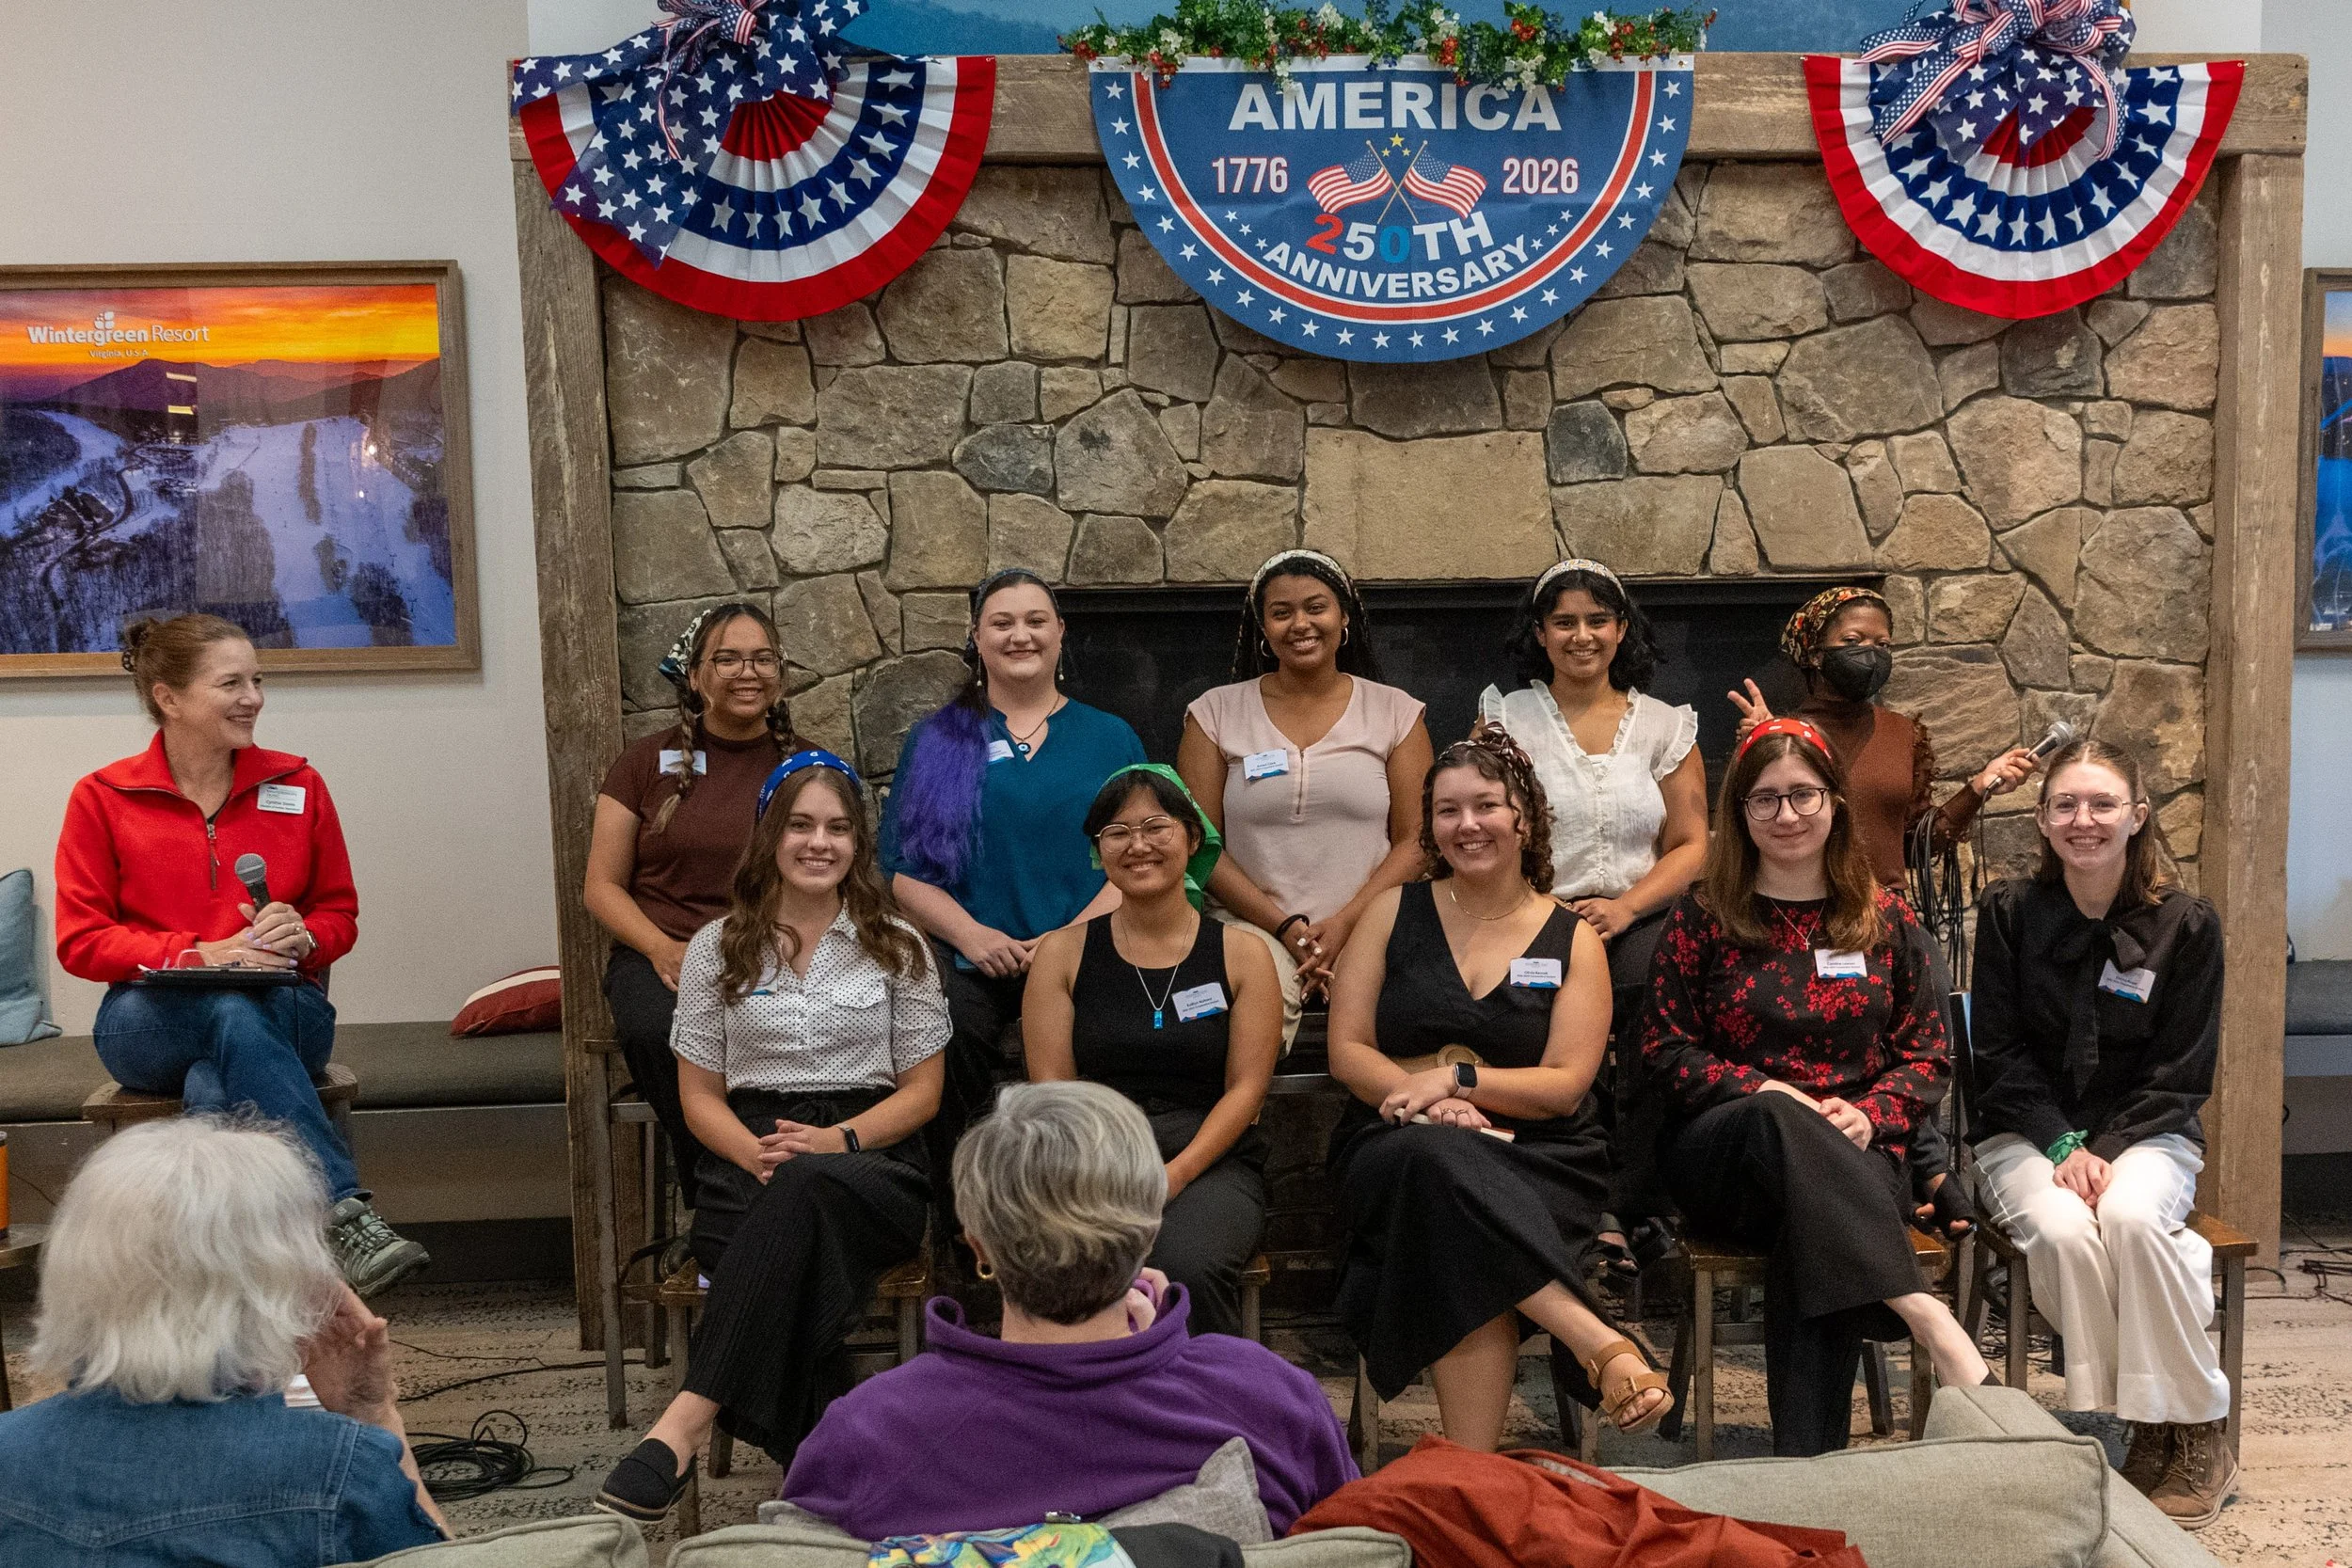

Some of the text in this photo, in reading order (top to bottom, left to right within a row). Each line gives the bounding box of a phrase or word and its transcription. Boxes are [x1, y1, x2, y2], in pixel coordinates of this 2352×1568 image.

[1227, 81, 1563, 132] AMERICA
[1211, 156, 1289, 195] 1776
[1502, 156, 1580, 196] 2026
[1305, 211, 1494, 264] 250TH
[1263, 234, 1529, 299] ANNIVERSARY
[27, 325, 211, 347] Wintergreen Resort
